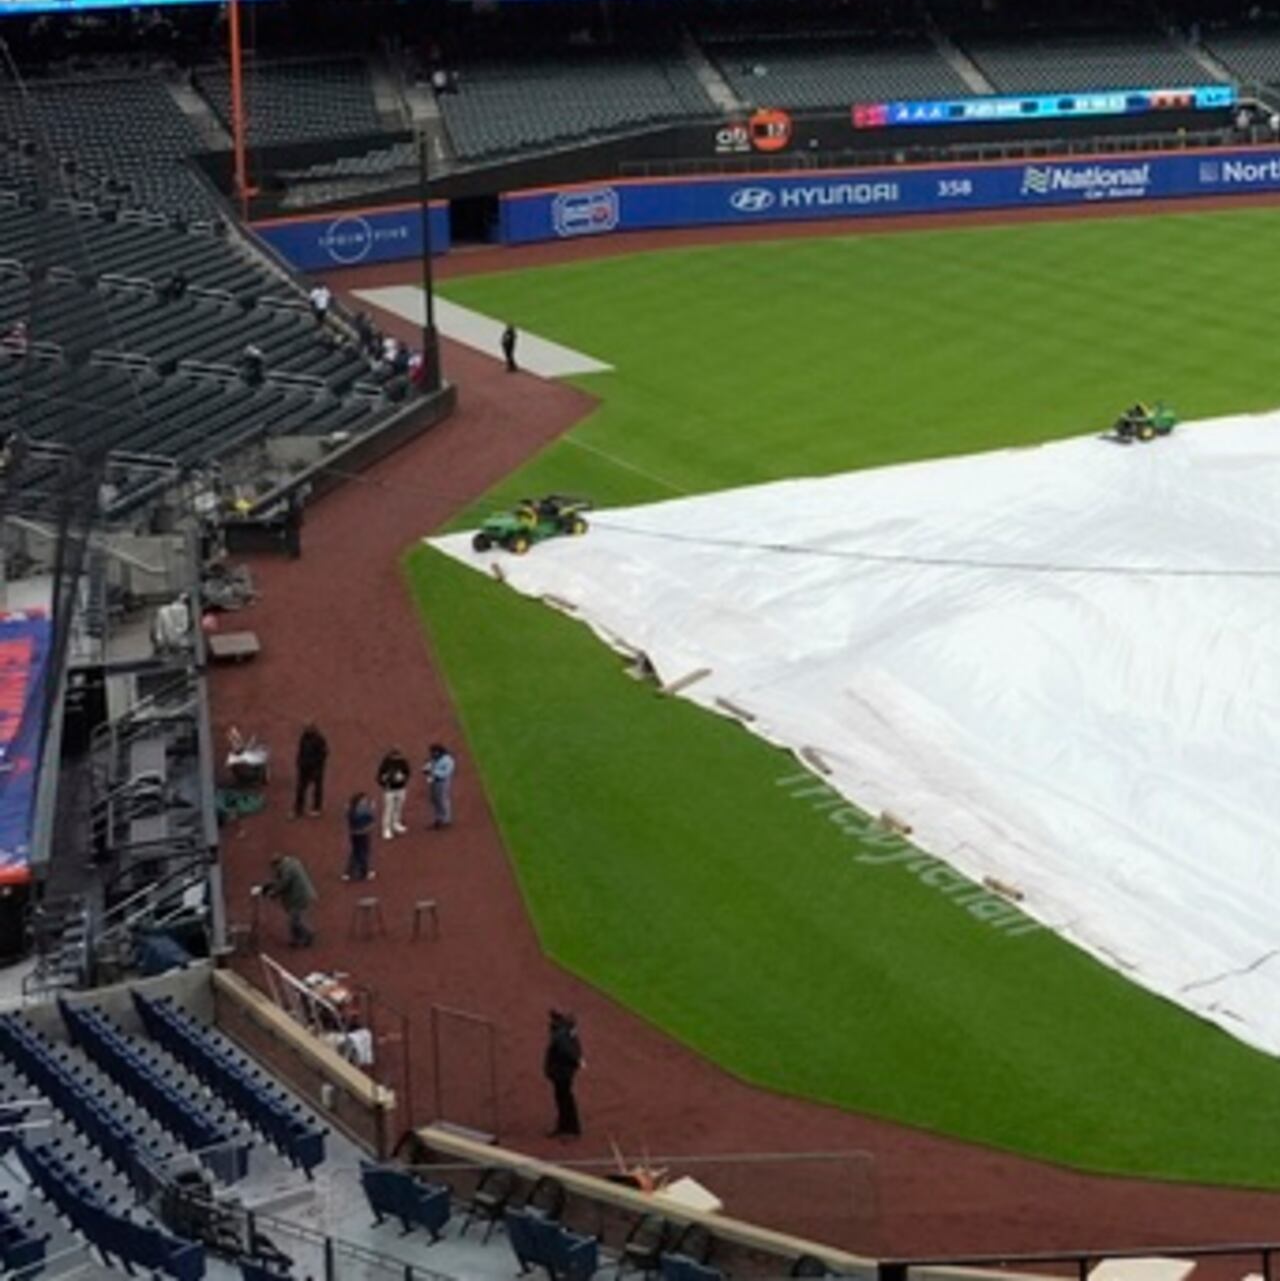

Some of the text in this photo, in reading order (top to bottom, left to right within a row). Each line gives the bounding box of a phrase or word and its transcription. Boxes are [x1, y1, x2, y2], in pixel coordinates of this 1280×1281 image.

[936, 179, 973, 198] 358
[1050, 163, 1151, 192] National
[780, 182, 899, 208] HYUNDAI
